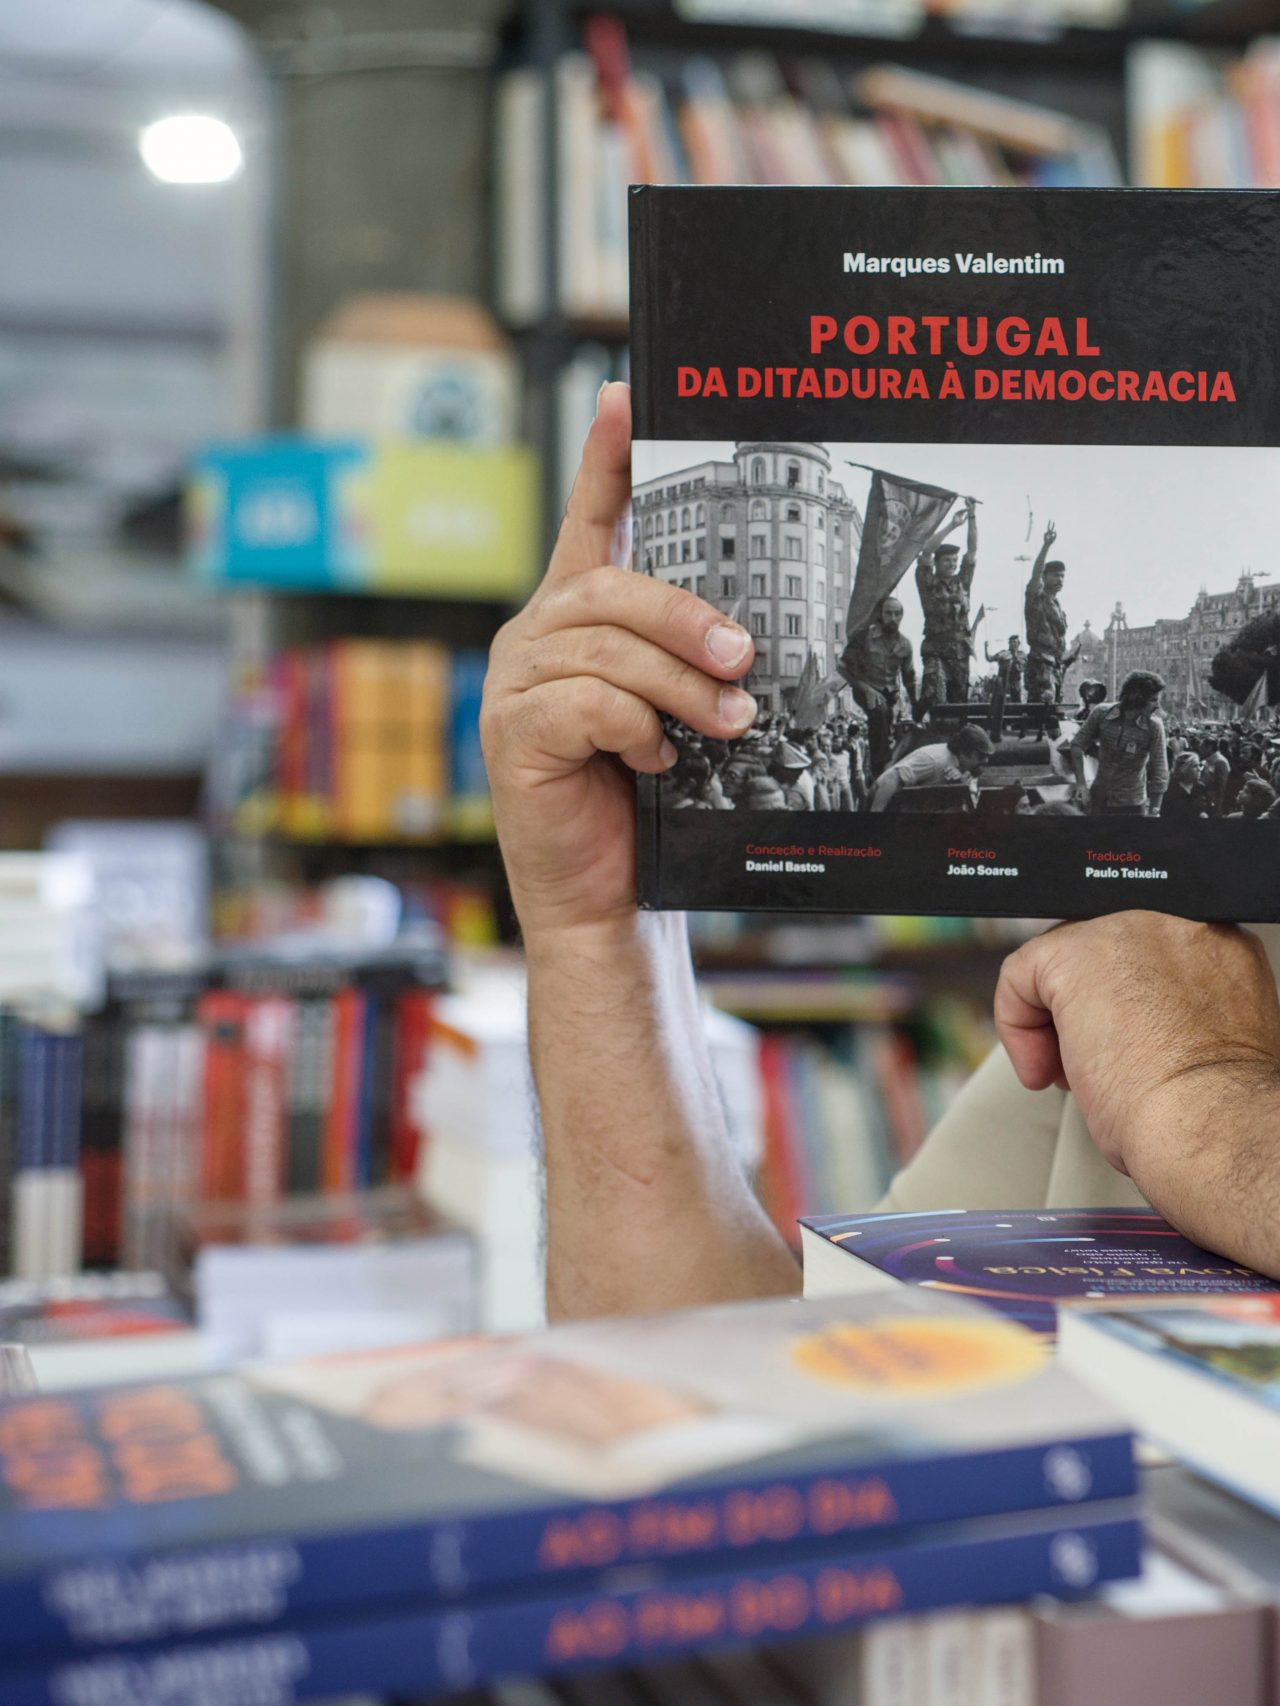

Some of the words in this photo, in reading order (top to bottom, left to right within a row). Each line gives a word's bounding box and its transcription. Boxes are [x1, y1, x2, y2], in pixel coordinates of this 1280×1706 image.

[843, 252, 951, 278] Marques
[955, 252, 1065, 275] Valentim
[810, 315, 1101, 357] PORTUGAL
[677, 366, 728, 398] DA
[737, 367, 930, 400] DITADURA
[938, 361, 965, 400] À
[974, 368, 1237, 403] DEMOCRACIA
[745, 844, 804, 857] Conceção
[807, 846, 815, 856] e
[818, 845, 882, 858] Realização
[947, 847, 997, 859] Prefácio
[1086, 850, 1142, 863] Tradução
[745, 860, 784, 872] Daniel
[785, 861, 826, 873] Bastos
[946, 864, 976, 876] João
[977, 865, 1019, 877] Soares
[1085, 867, 1120, 879] Paulo
[1120, 868, 1168, 880] Teixeira
